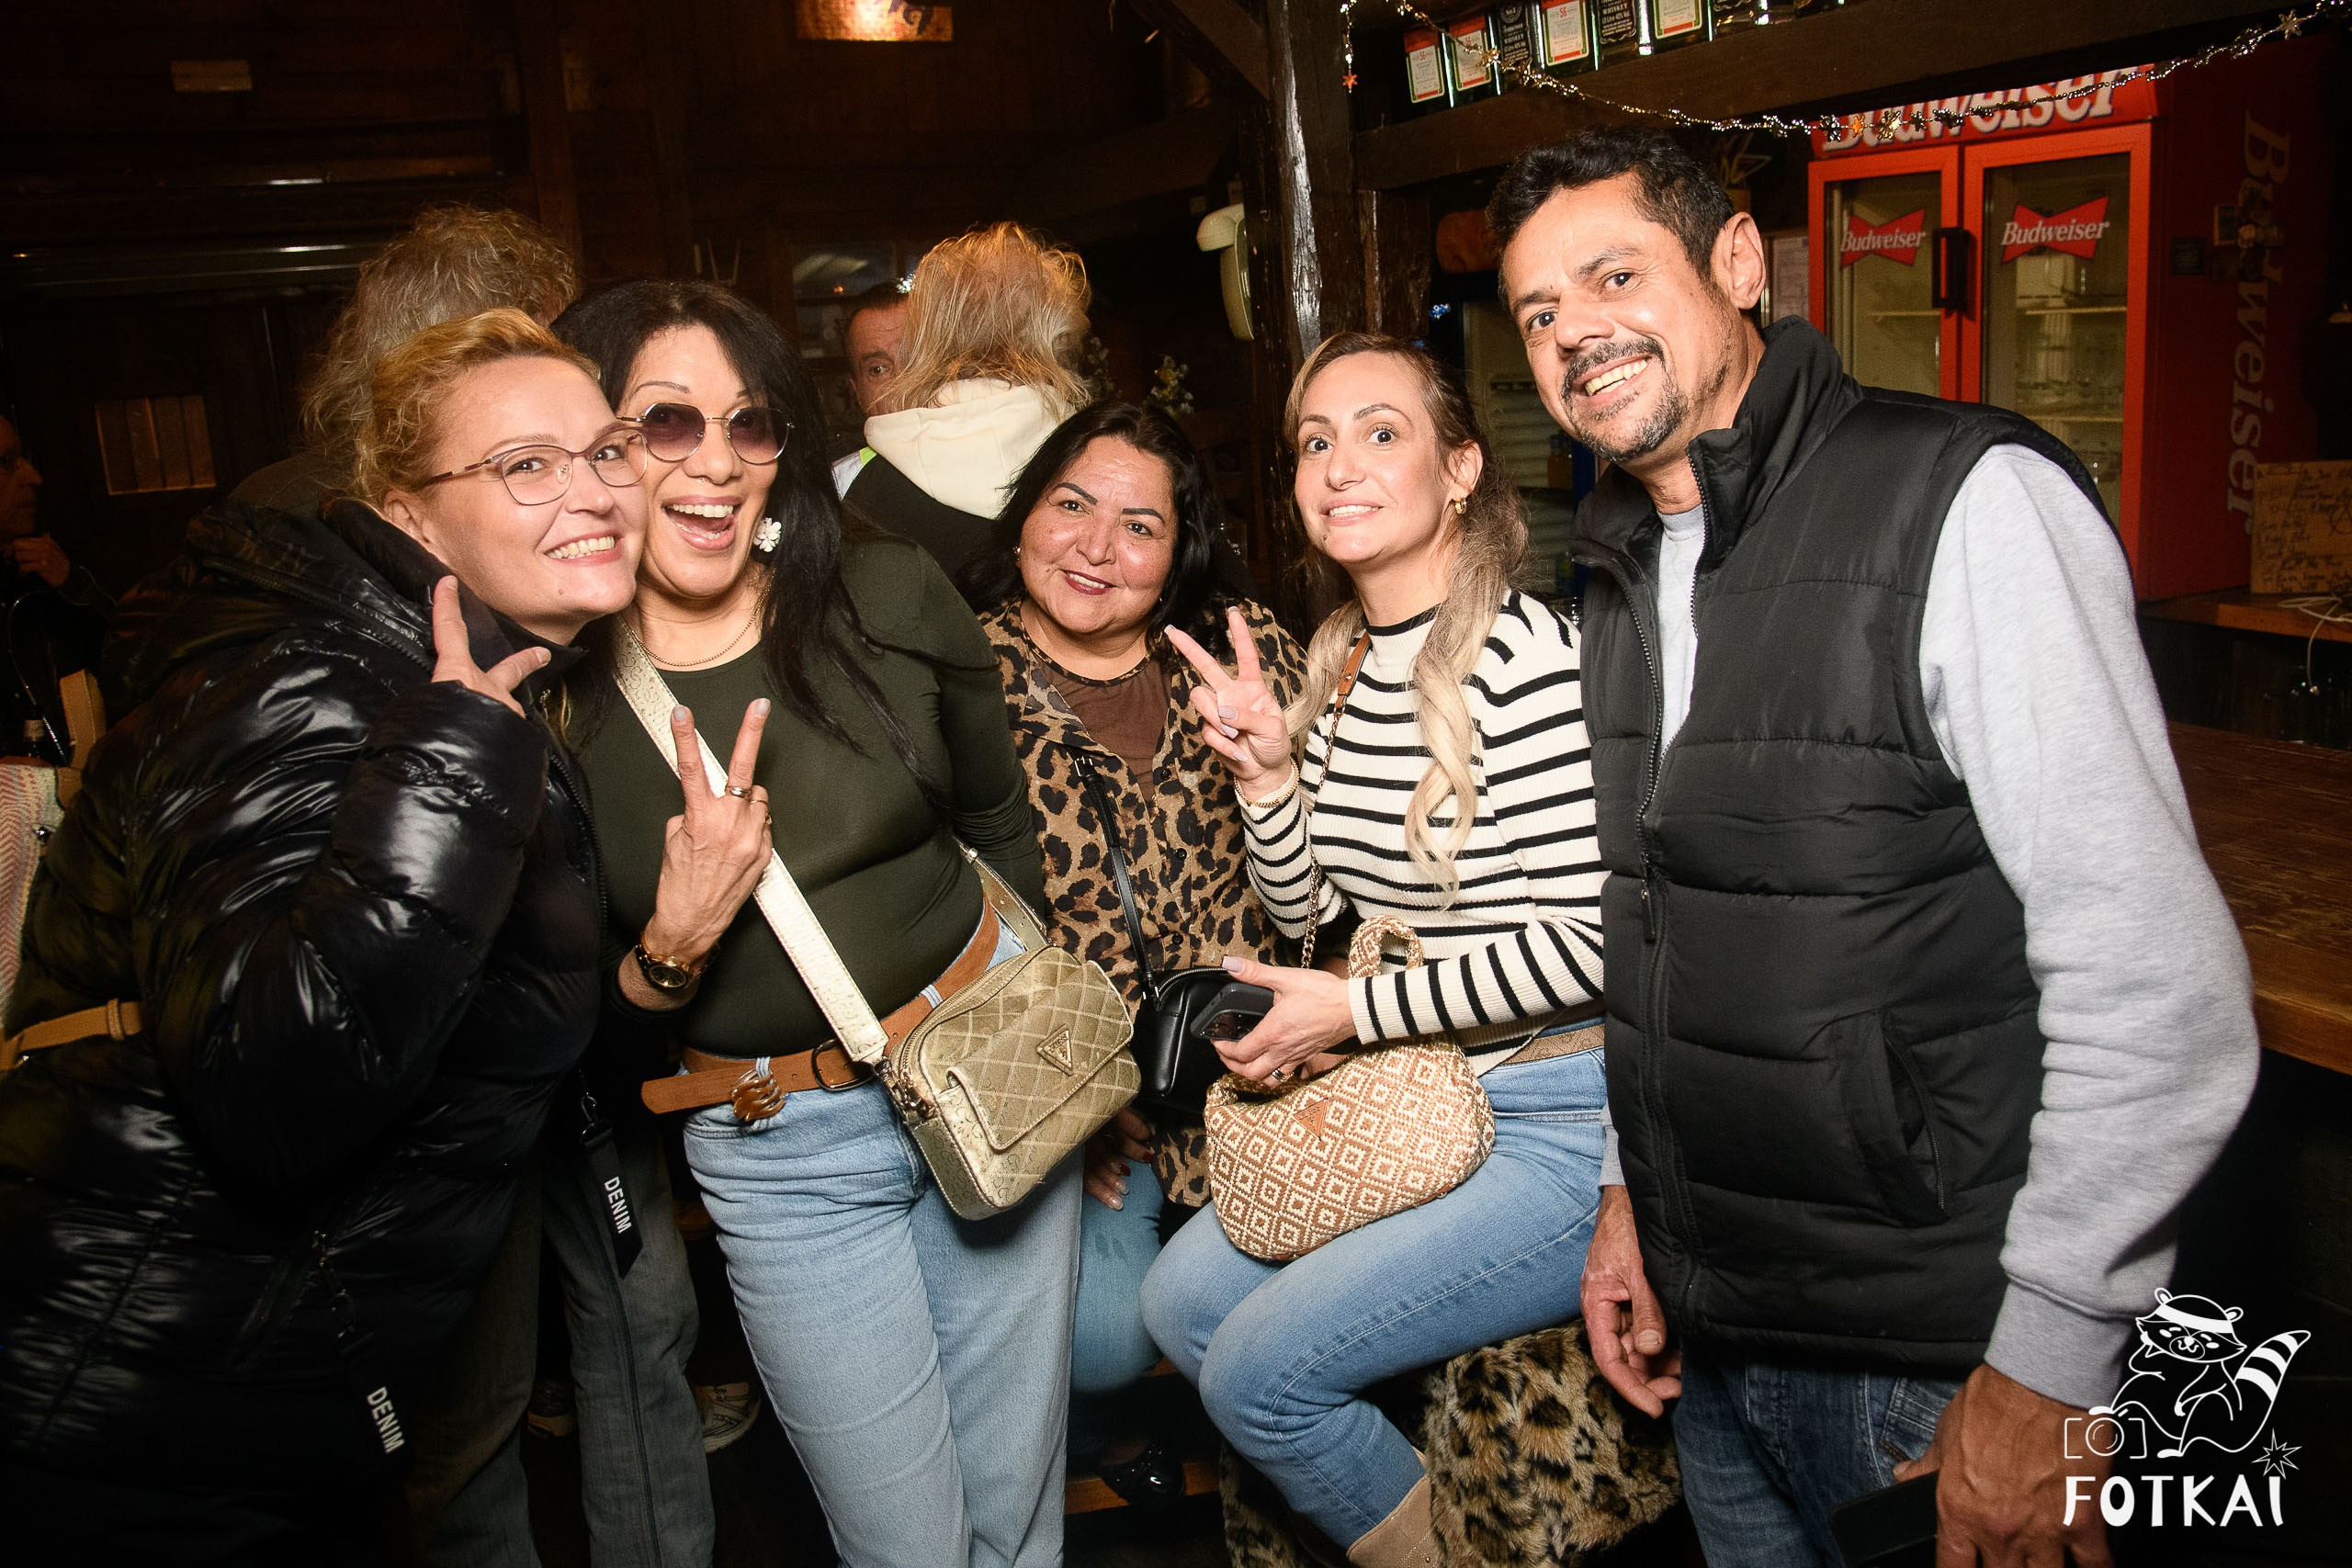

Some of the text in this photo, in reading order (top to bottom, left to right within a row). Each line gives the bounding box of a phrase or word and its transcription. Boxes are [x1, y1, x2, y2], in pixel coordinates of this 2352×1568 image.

[1839, 228, 1927, 253] Budweiser
[2000, 218, 2110, 246] Budweiser
[605, 1176, 632, 1234] DENIM
[368, 1386, 404, 1453] DENIM
